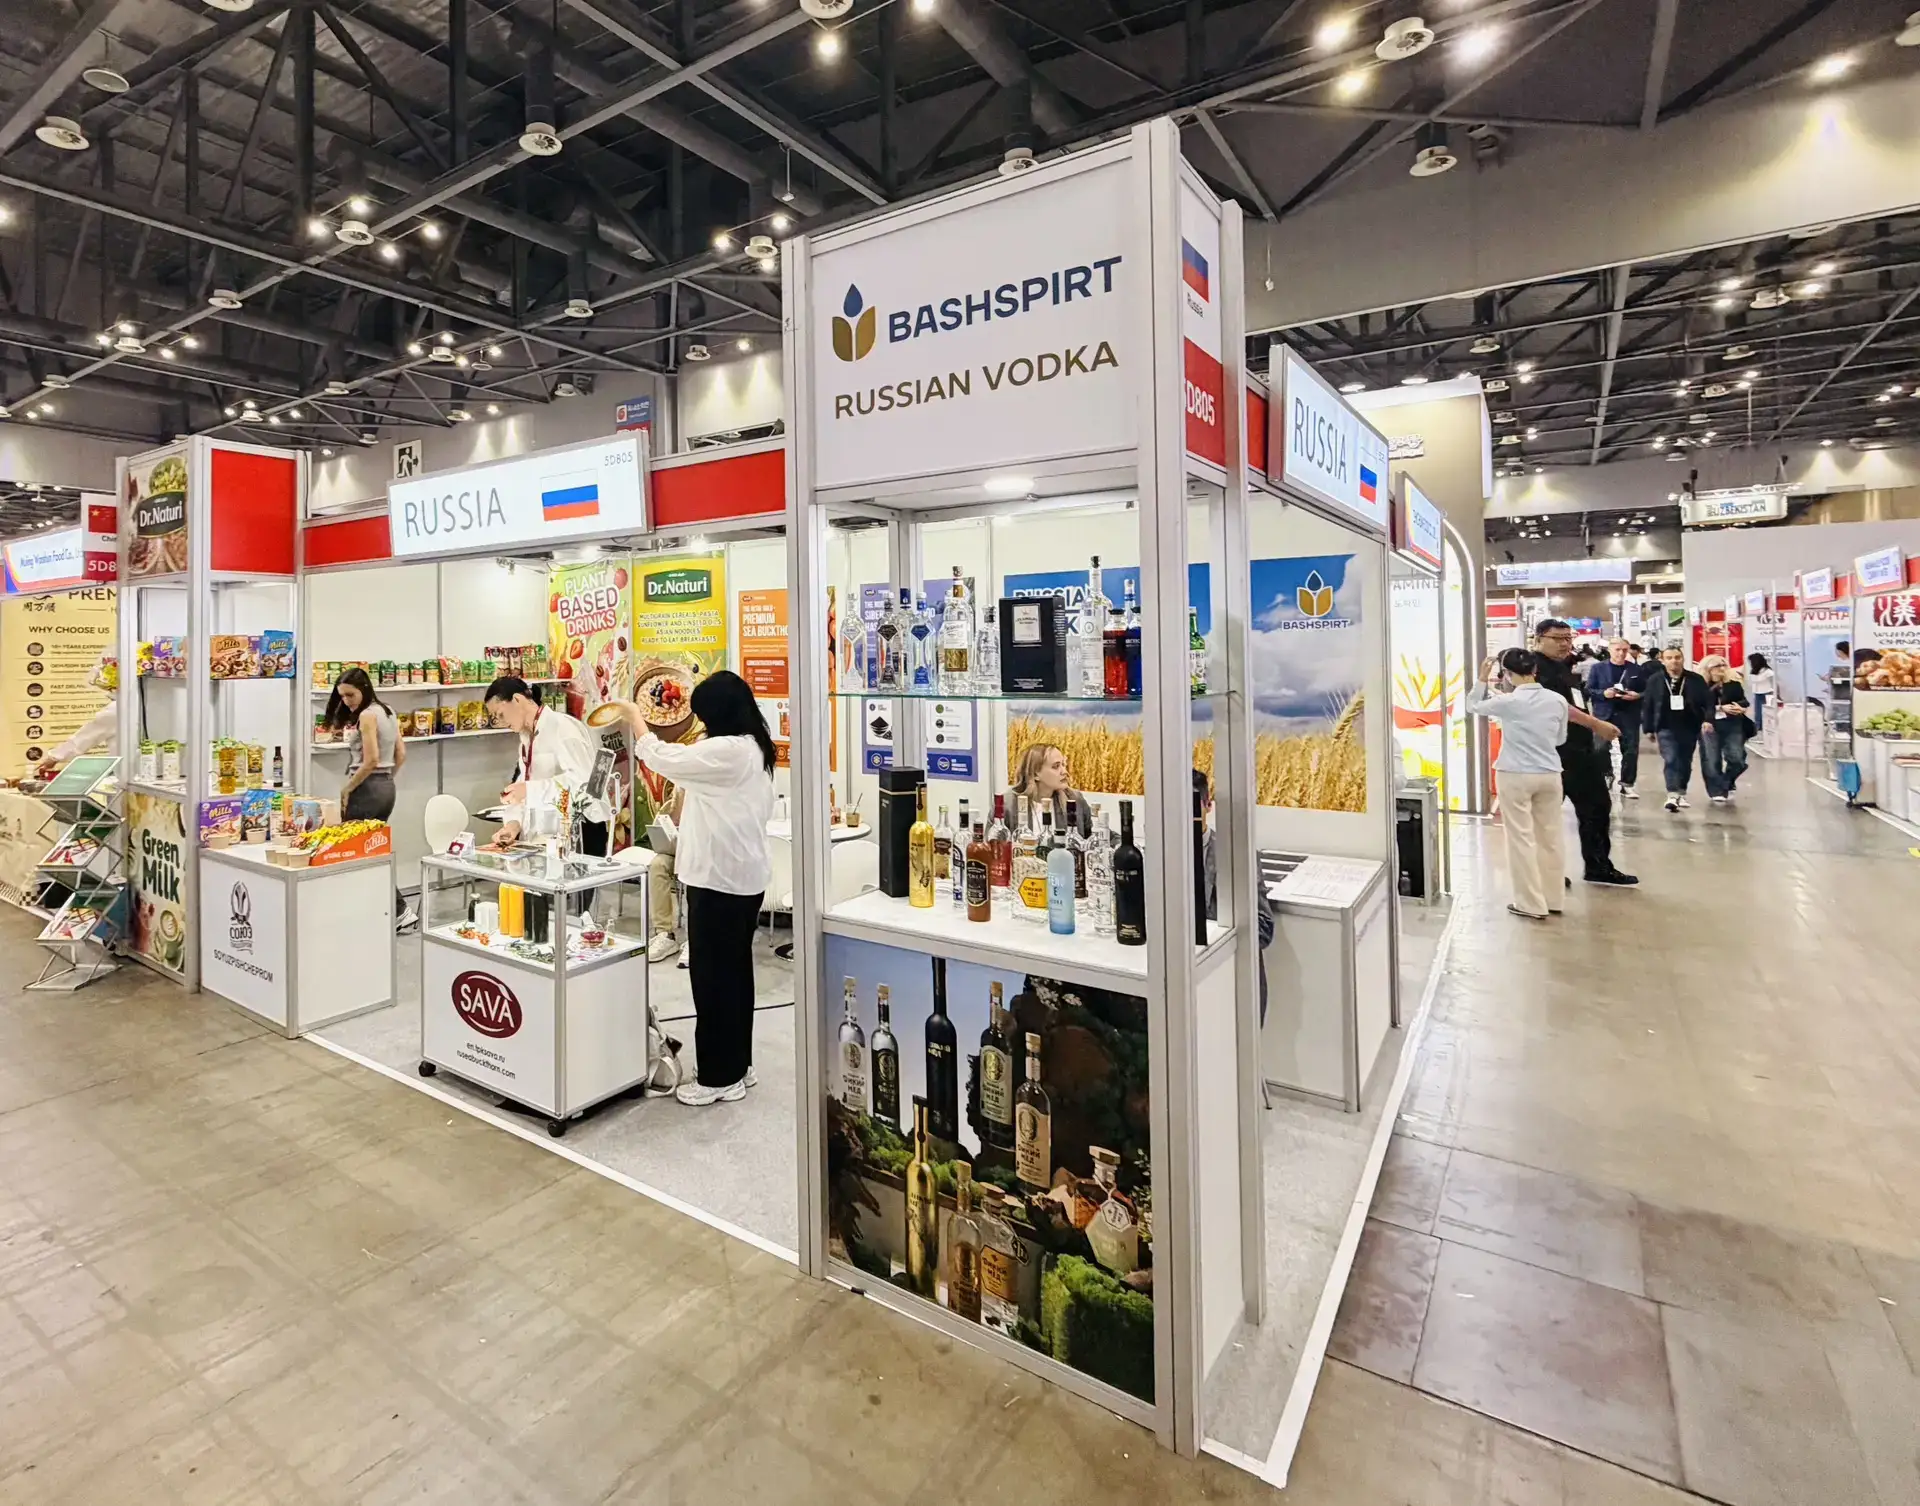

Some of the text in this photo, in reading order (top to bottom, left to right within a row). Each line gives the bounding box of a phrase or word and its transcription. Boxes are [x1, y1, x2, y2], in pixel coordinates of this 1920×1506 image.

[888, 255, 1122, 344] BASHSPIRT
[835, 340, 1119, 419] RUSSIAN VODKA
[1184, 379, 1215, 427] D805
[1294, 397, 1347, 484] RUSSIA
[604, 451, 633, 467] 5D805
[140, 500, 183, 527] Dr.Naturi
[404, 487, 506, 538] RUSSIA
[565, 569, 606, 596] PLANT
[647, 576, 708, 596] Dr.Naturi
[560, 587, 619, 619] BASED
[55, 626, 95, 634] CHOOSE
[566, 609, 617, 638] DRINKS
[743, 613, 775, 624] PREMIUM
[743, 625, 756, 637] SEA
[1283, 620, 1349, 630] BASHSPIRT
[601, 731, 623, 742] Green
[602, 739, 625, 751] Milk
[142, 828, 180, 869] Green
[142, 856, 180, 904] Milk
[460, 983, 515, 1029] SAVA
